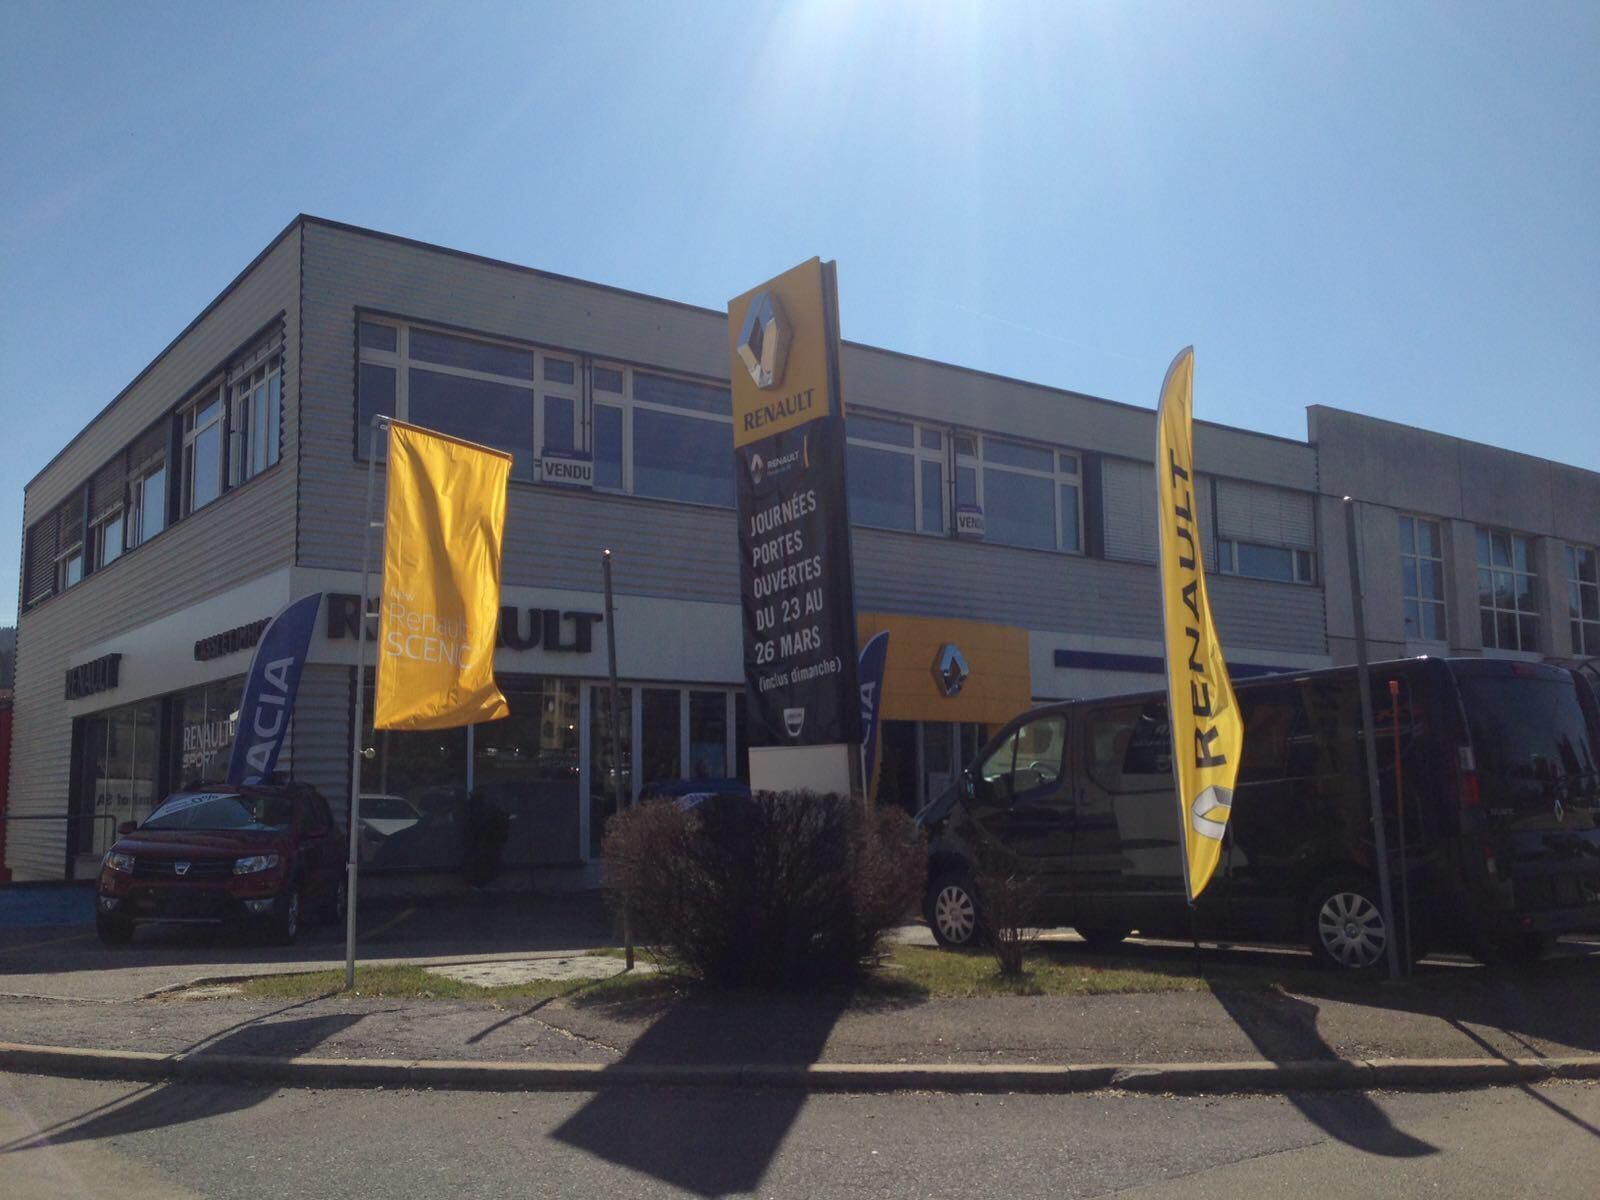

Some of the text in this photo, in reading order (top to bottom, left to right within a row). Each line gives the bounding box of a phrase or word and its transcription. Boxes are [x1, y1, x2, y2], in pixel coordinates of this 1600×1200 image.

[744, 388, 816, 432] RENAULT
[545, 462, 592, 480] VENDU
[767, 450, 800, 469] RENAULT
[751, 490, 816, 537] JOURNÉES
[753, 530, 803, 568] PORTES
[753, 555, 822, 599] OUVERTES
[756, 588, 823, 630] DU 23 AU
[1168, 447, 1227, 768] RENAULT
[755, 625, 821, 665] 26 MARS
[759, 656, 842, 692] (inclus dimanche)
[184, 721, 229, 751] RENAULT
